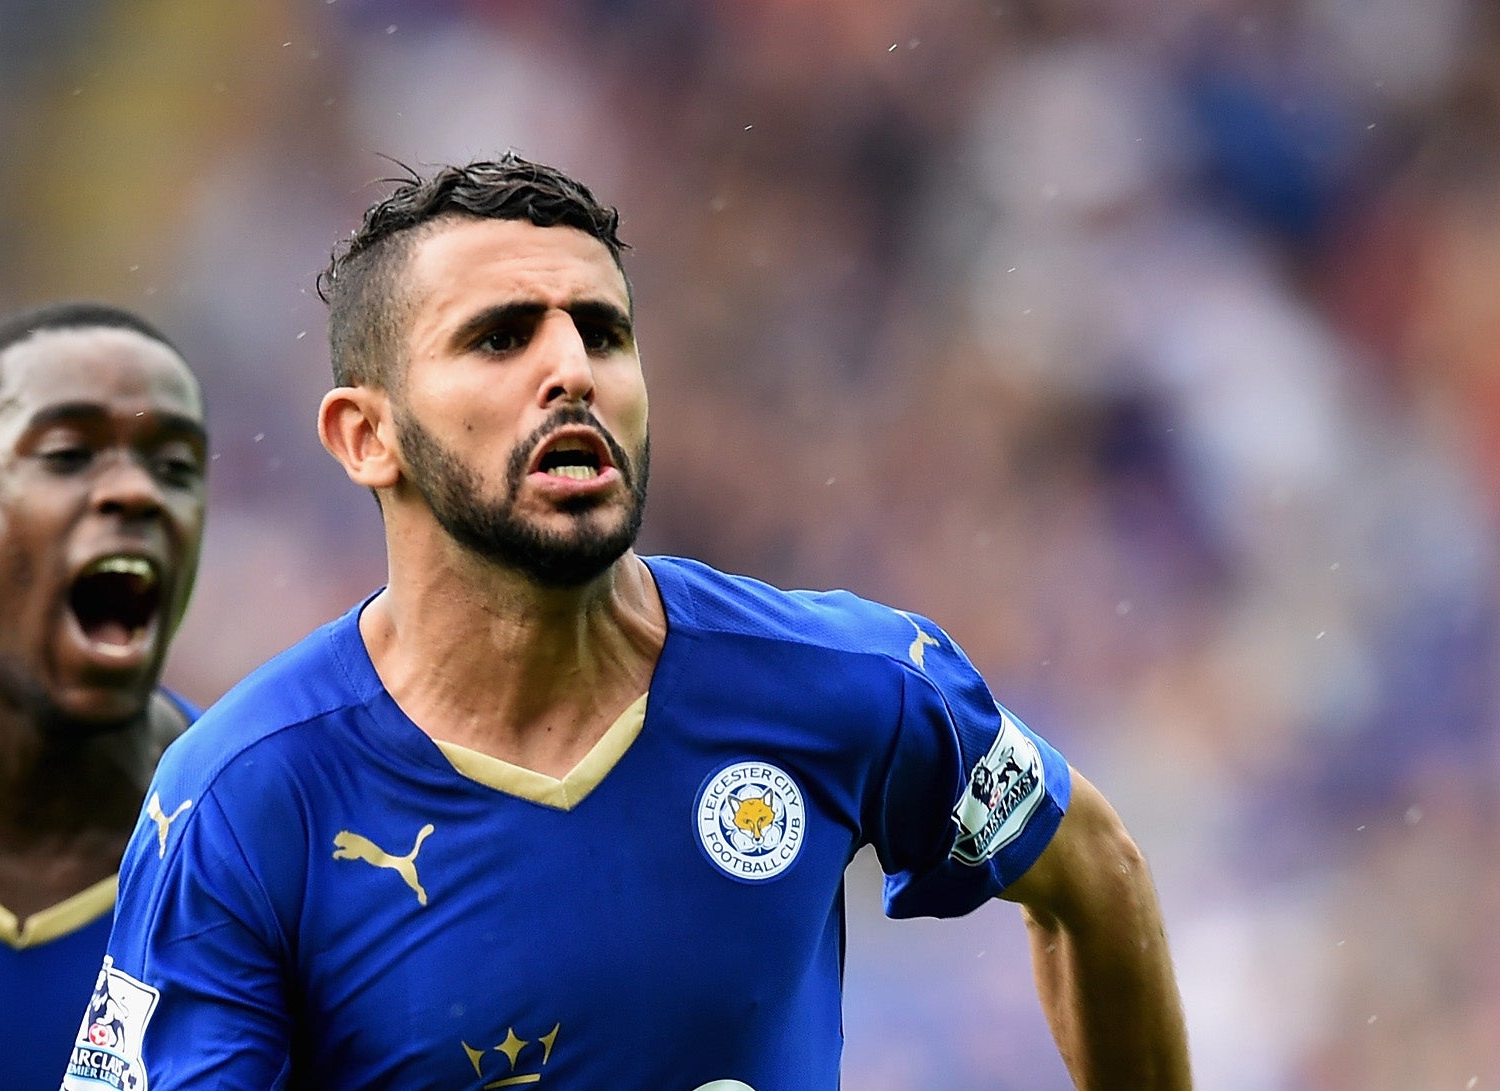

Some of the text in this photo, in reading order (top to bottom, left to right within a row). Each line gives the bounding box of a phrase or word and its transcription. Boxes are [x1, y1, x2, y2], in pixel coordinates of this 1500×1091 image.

[703, 767, 800, 821] LEICESTER CITY
[705, 817, 801, 874] FOOTBALL CLUB
[70, 1047, 125, 1076] ARCLAYS
